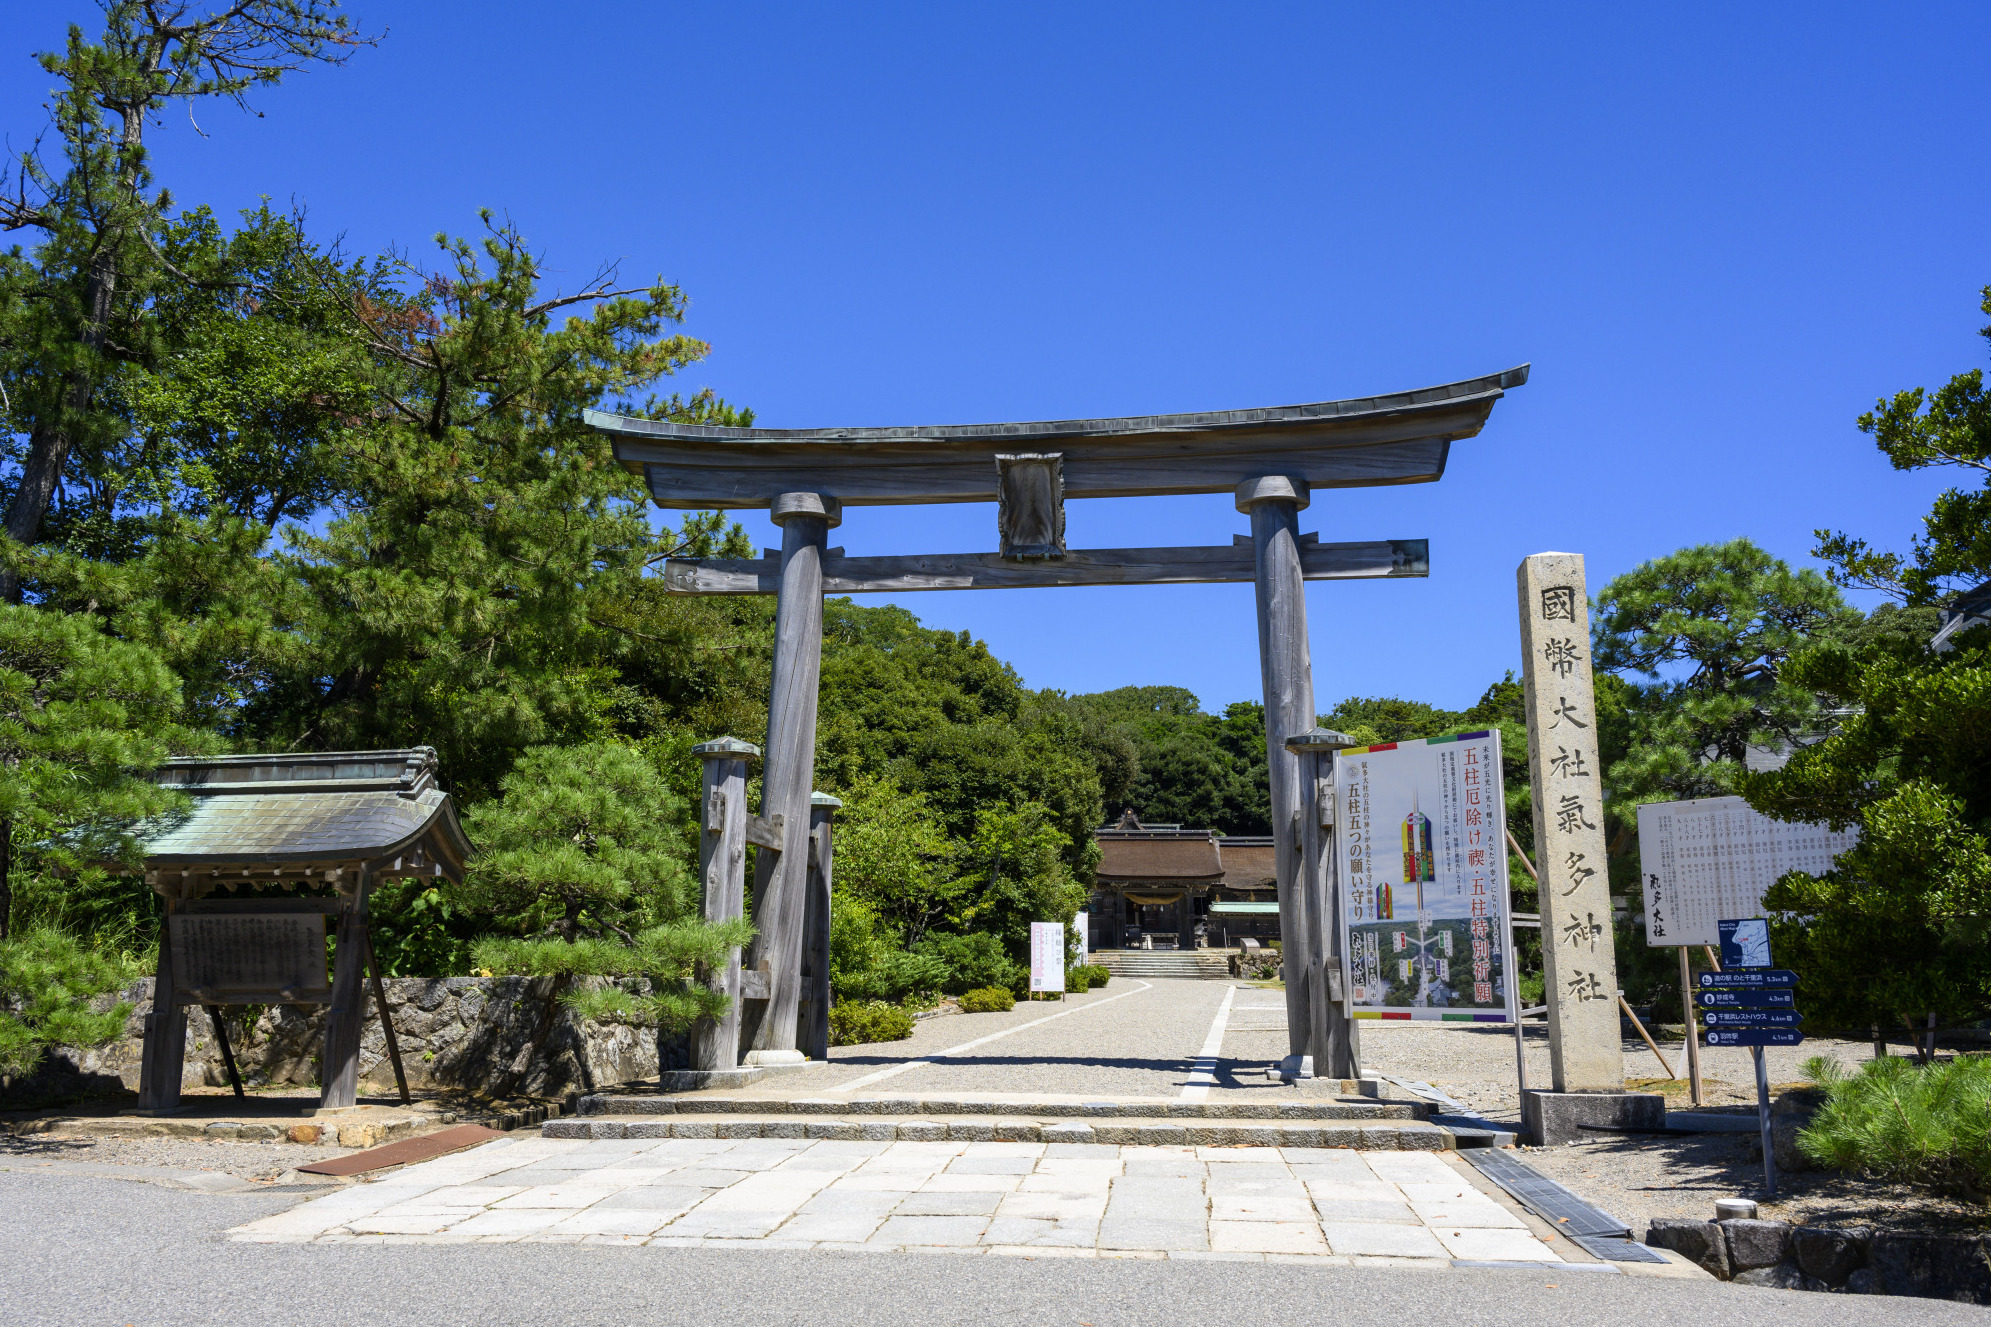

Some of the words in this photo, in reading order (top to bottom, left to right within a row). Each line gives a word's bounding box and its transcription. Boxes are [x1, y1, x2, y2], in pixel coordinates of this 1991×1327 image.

[1347, 782, 1365, 921] 五柱五つの願い守り
[1541, 585, 1608, 1003] 國幣大社氣多神社
